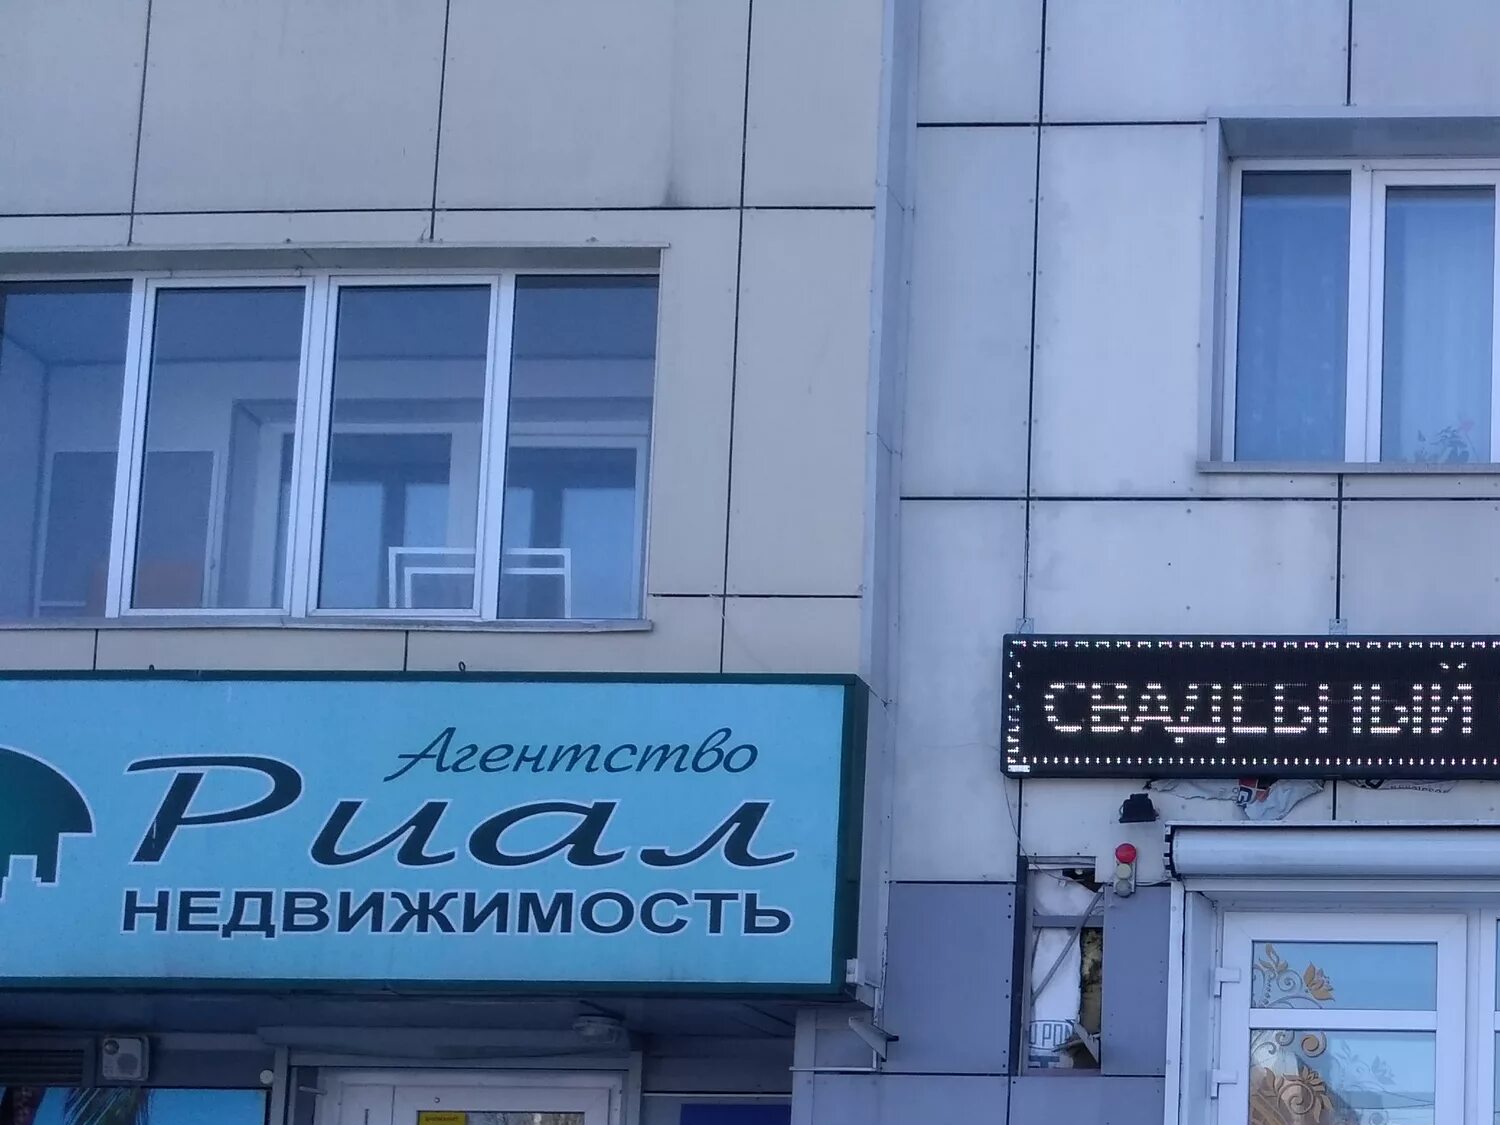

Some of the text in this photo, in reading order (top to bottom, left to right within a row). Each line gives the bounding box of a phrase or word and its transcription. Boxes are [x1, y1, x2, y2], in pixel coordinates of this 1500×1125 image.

[383, 726, 759, 782] Агентство
[126, 755, 796, 868] Риал
[122, 890, 792, 938] НЕДВИЖИМОСТЬ
